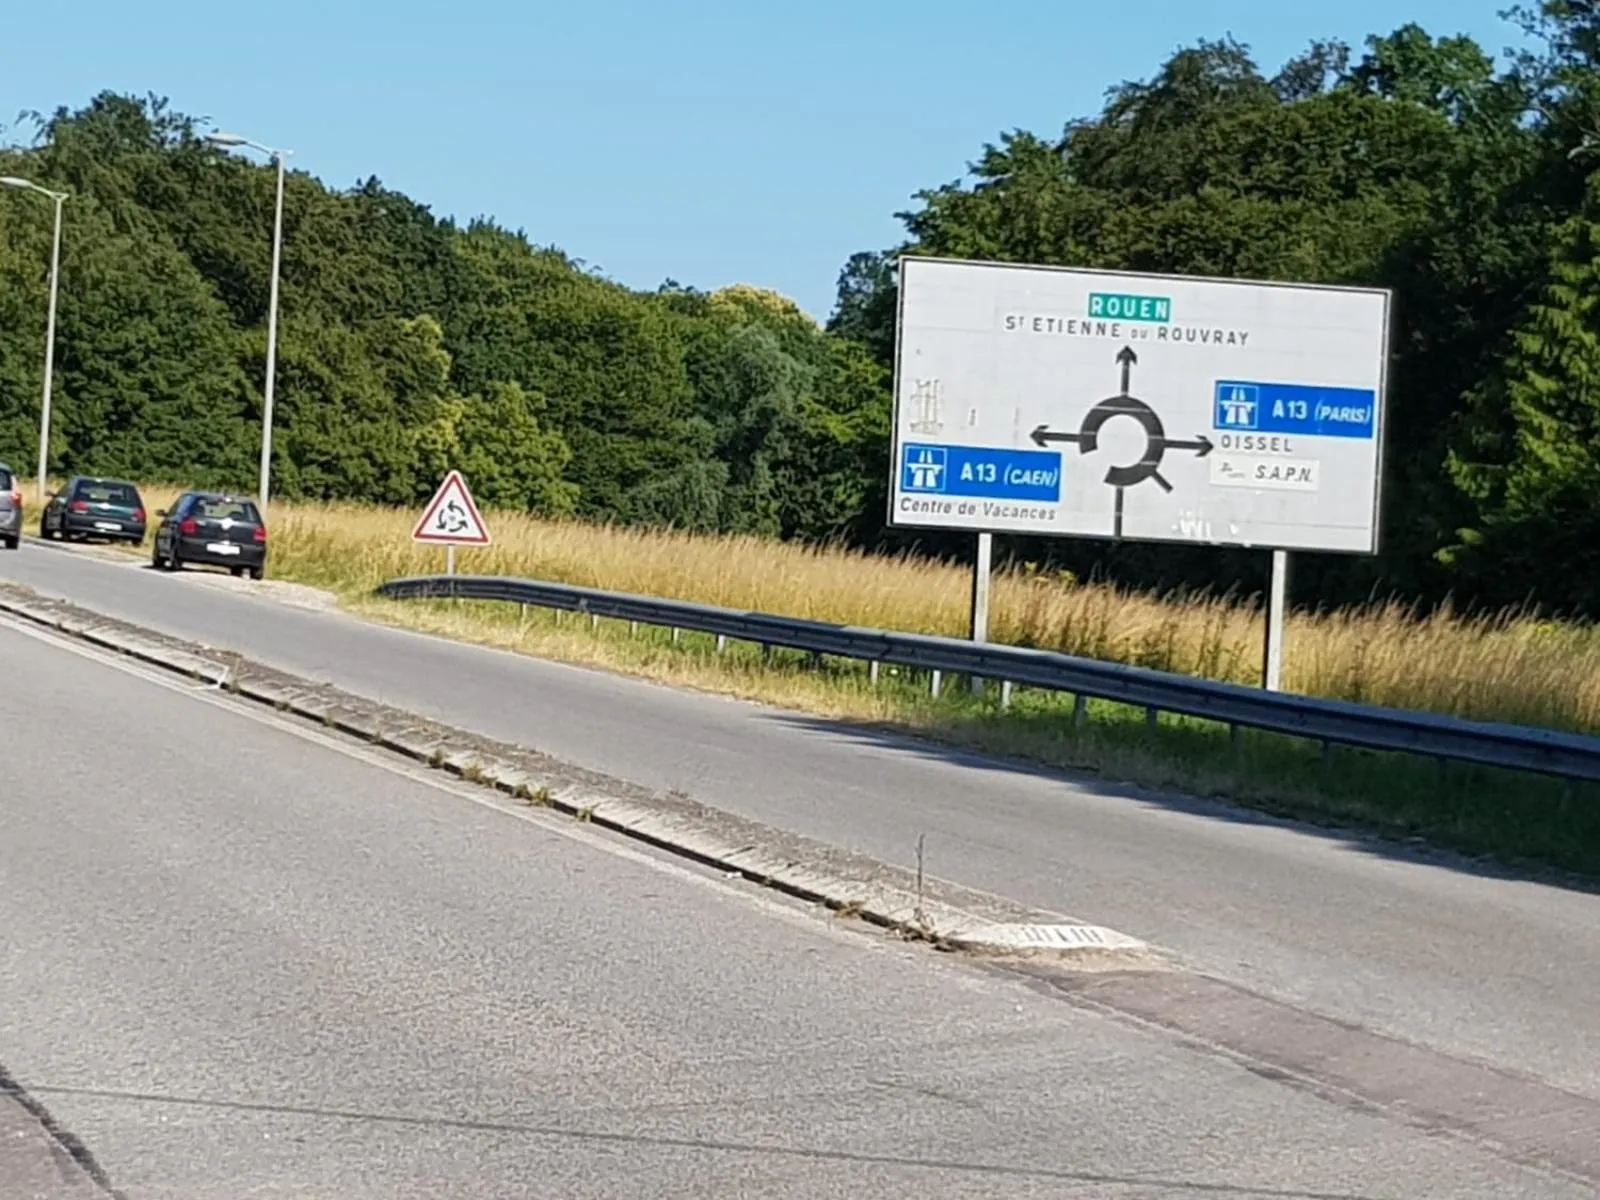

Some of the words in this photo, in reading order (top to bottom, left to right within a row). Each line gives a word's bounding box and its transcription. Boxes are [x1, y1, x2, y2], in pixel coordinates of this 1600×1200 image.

[1090, 297, 1168, 319] ROUEN
[1033, 317, 1121, 338] ETIENNE
[1157, 326, 1249, 346] ROUVRAY
[1314, 398, 1371, 425] (PARIS)
[1220, 434, 1293, 453] OISSEL
[1003, 463, 1059, 487] (CAEN)
[900, 497, 953, 514] Centre
[958, 501, 977, 515] de
[983, 502, 1056, 521] Vacances
